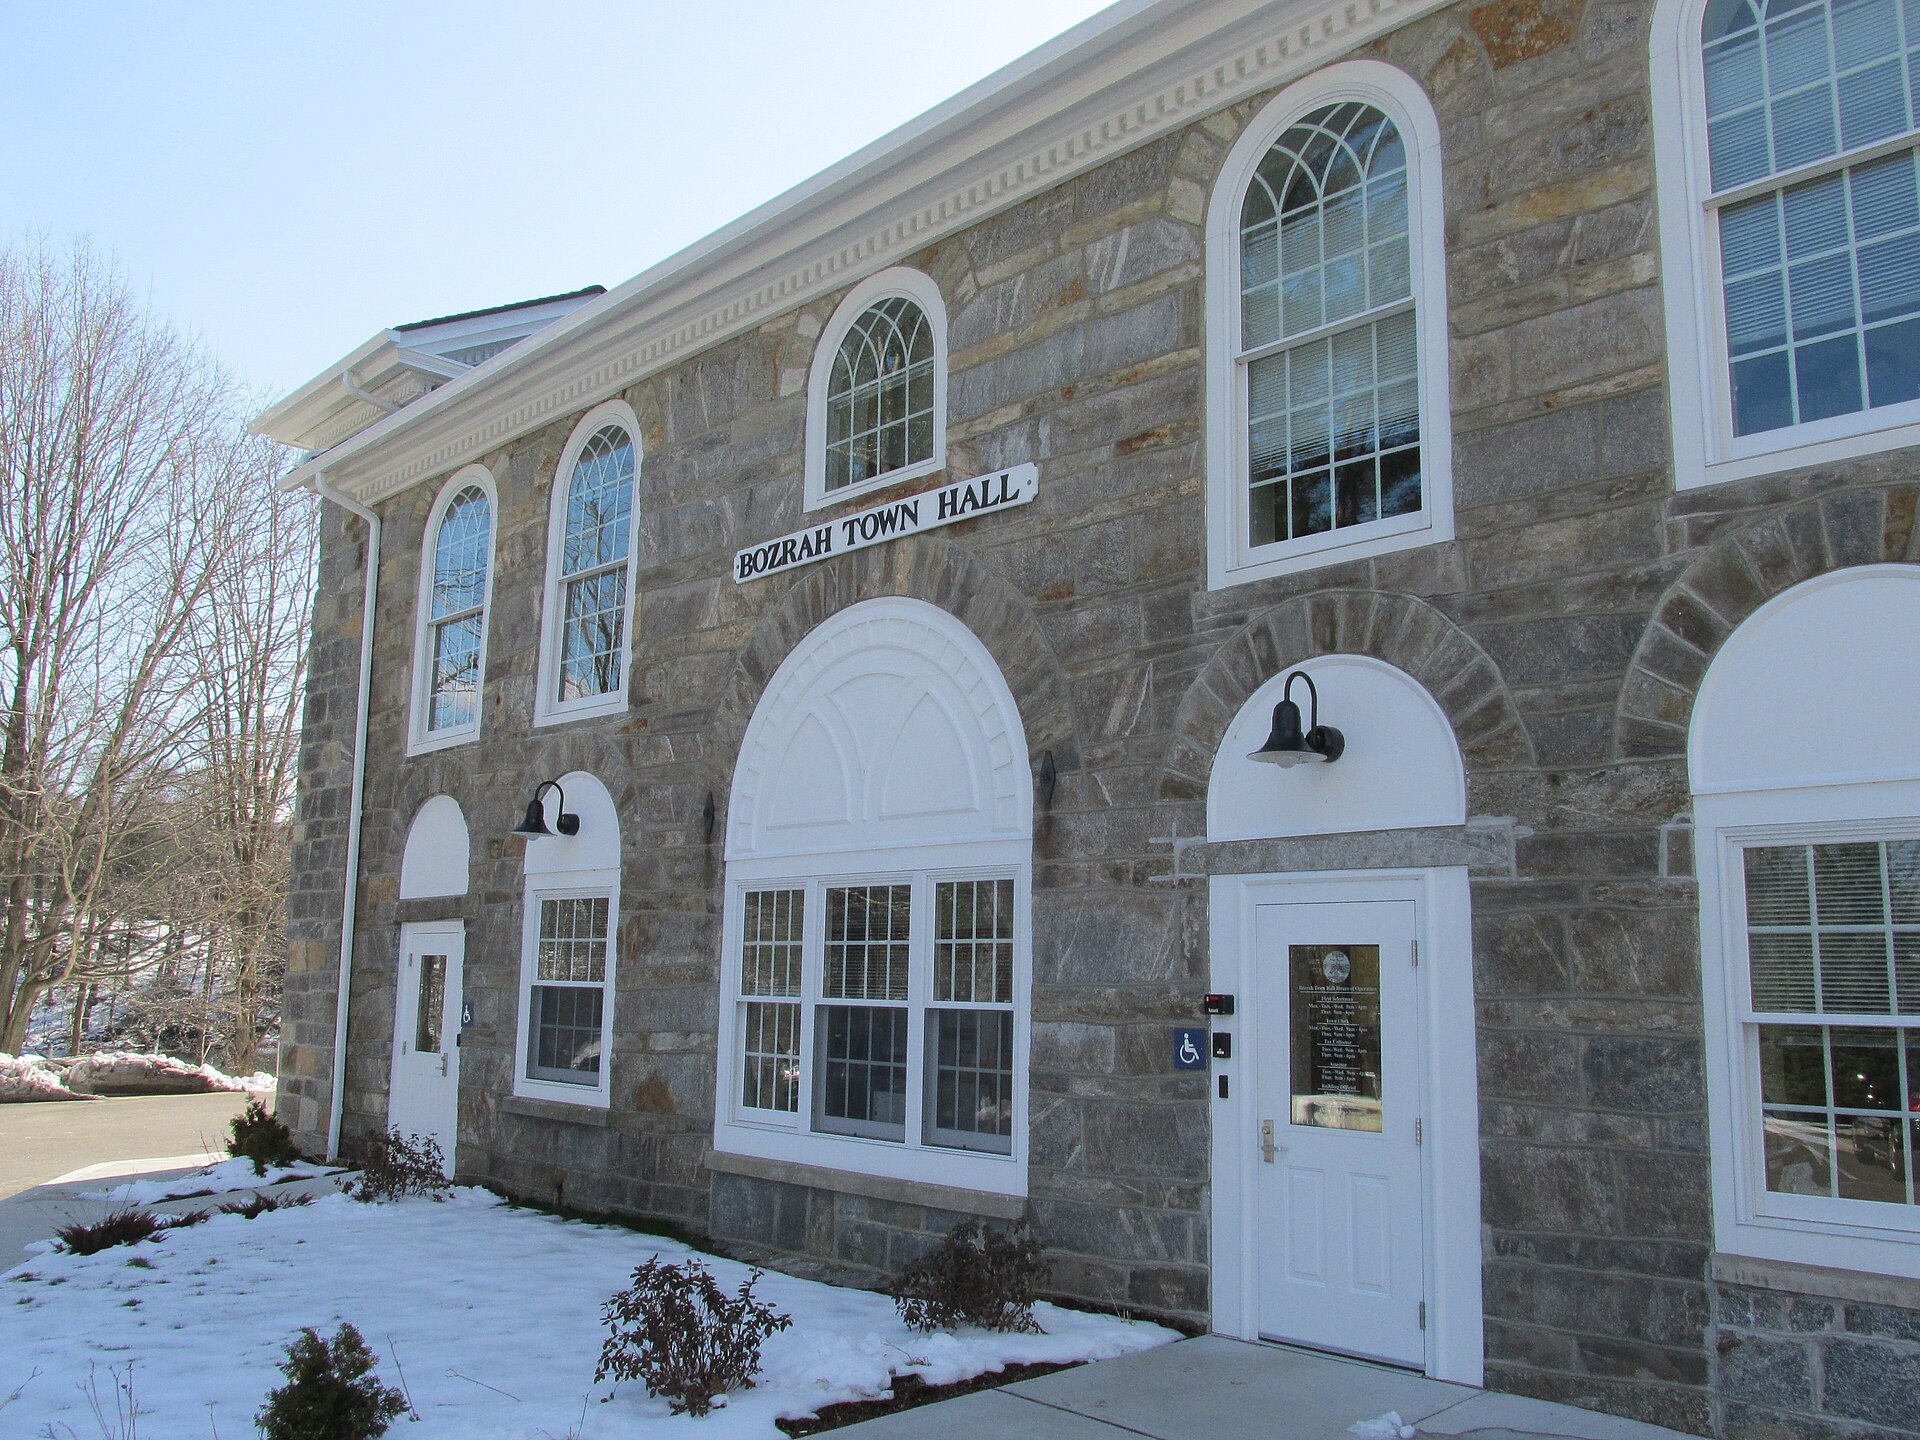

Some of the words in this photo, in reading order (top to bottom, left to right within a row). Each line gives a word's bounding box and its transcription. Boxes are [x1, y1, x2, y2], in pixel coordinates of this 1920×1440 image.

[739, 526, 832, 579] BOZRAH
[842, 499, 919, 546] TOWN
[937, 474, 1020, 521] HALL
